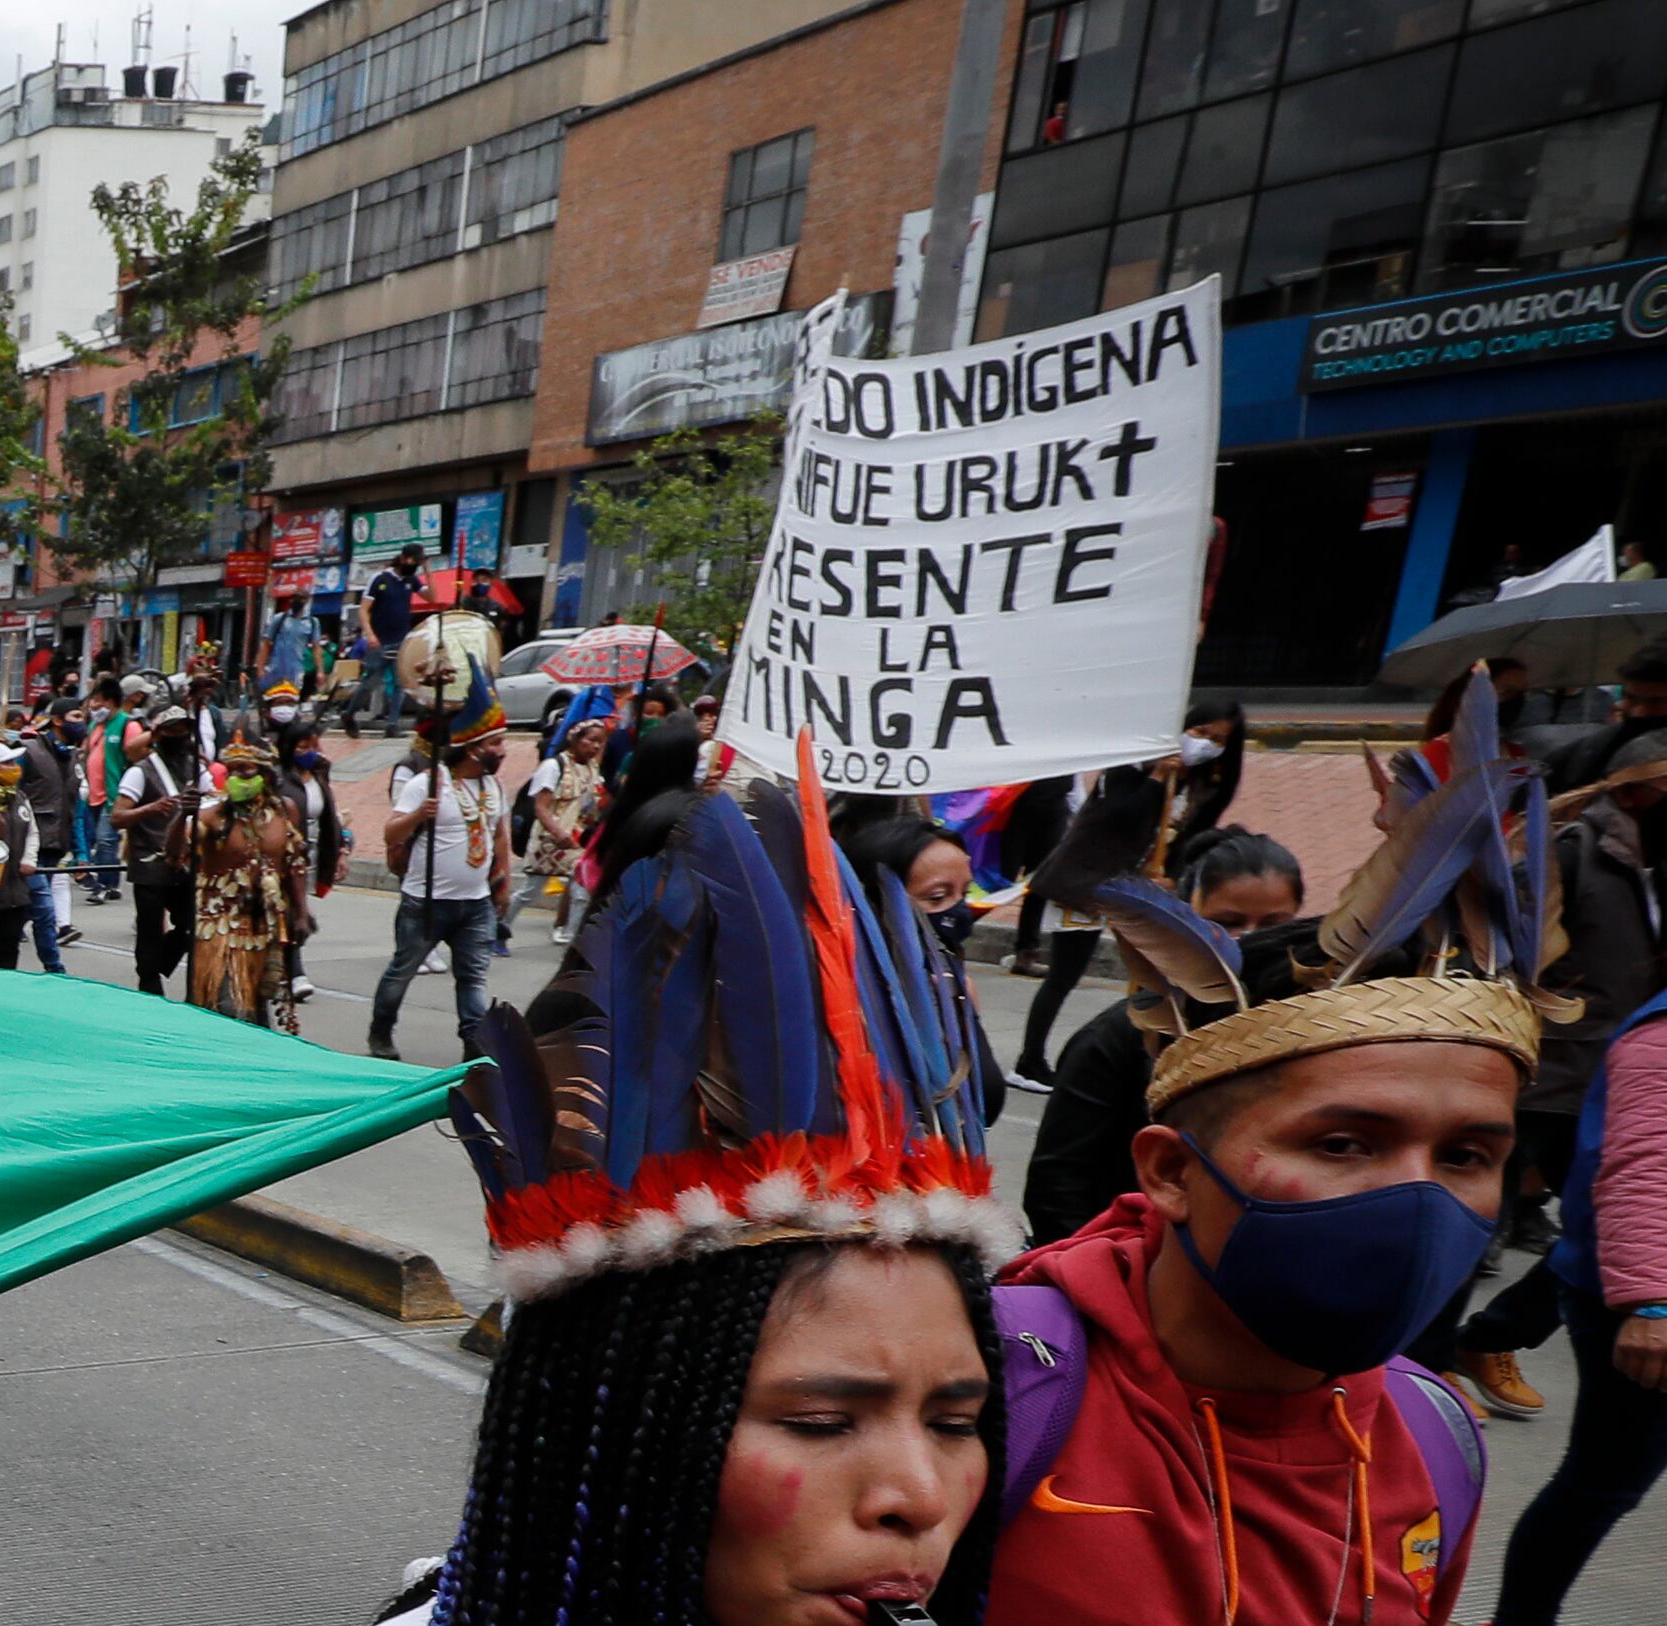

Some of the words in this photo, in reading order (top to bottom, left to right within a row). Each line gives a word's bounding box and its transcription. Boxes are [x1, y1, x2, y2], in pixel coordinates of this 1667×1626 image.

[1313, 350, 1436, 381] TECHNOLOGY
[1438, 339, 1483, 362] AND
[1486, 320, 1618, 356] COMPUTERS
[1315, 312, 1433, 355] CENTRO
[1435, 282, 1622, 336] COMERCIAL
[768, 523, 1121, 620] RESENTE
[768, 609, 815, 665] EN
[879, 624, 962, 673] LA
[742, 644, 1012, 750] MINGA
[820, 748, 931, 791] 2020
